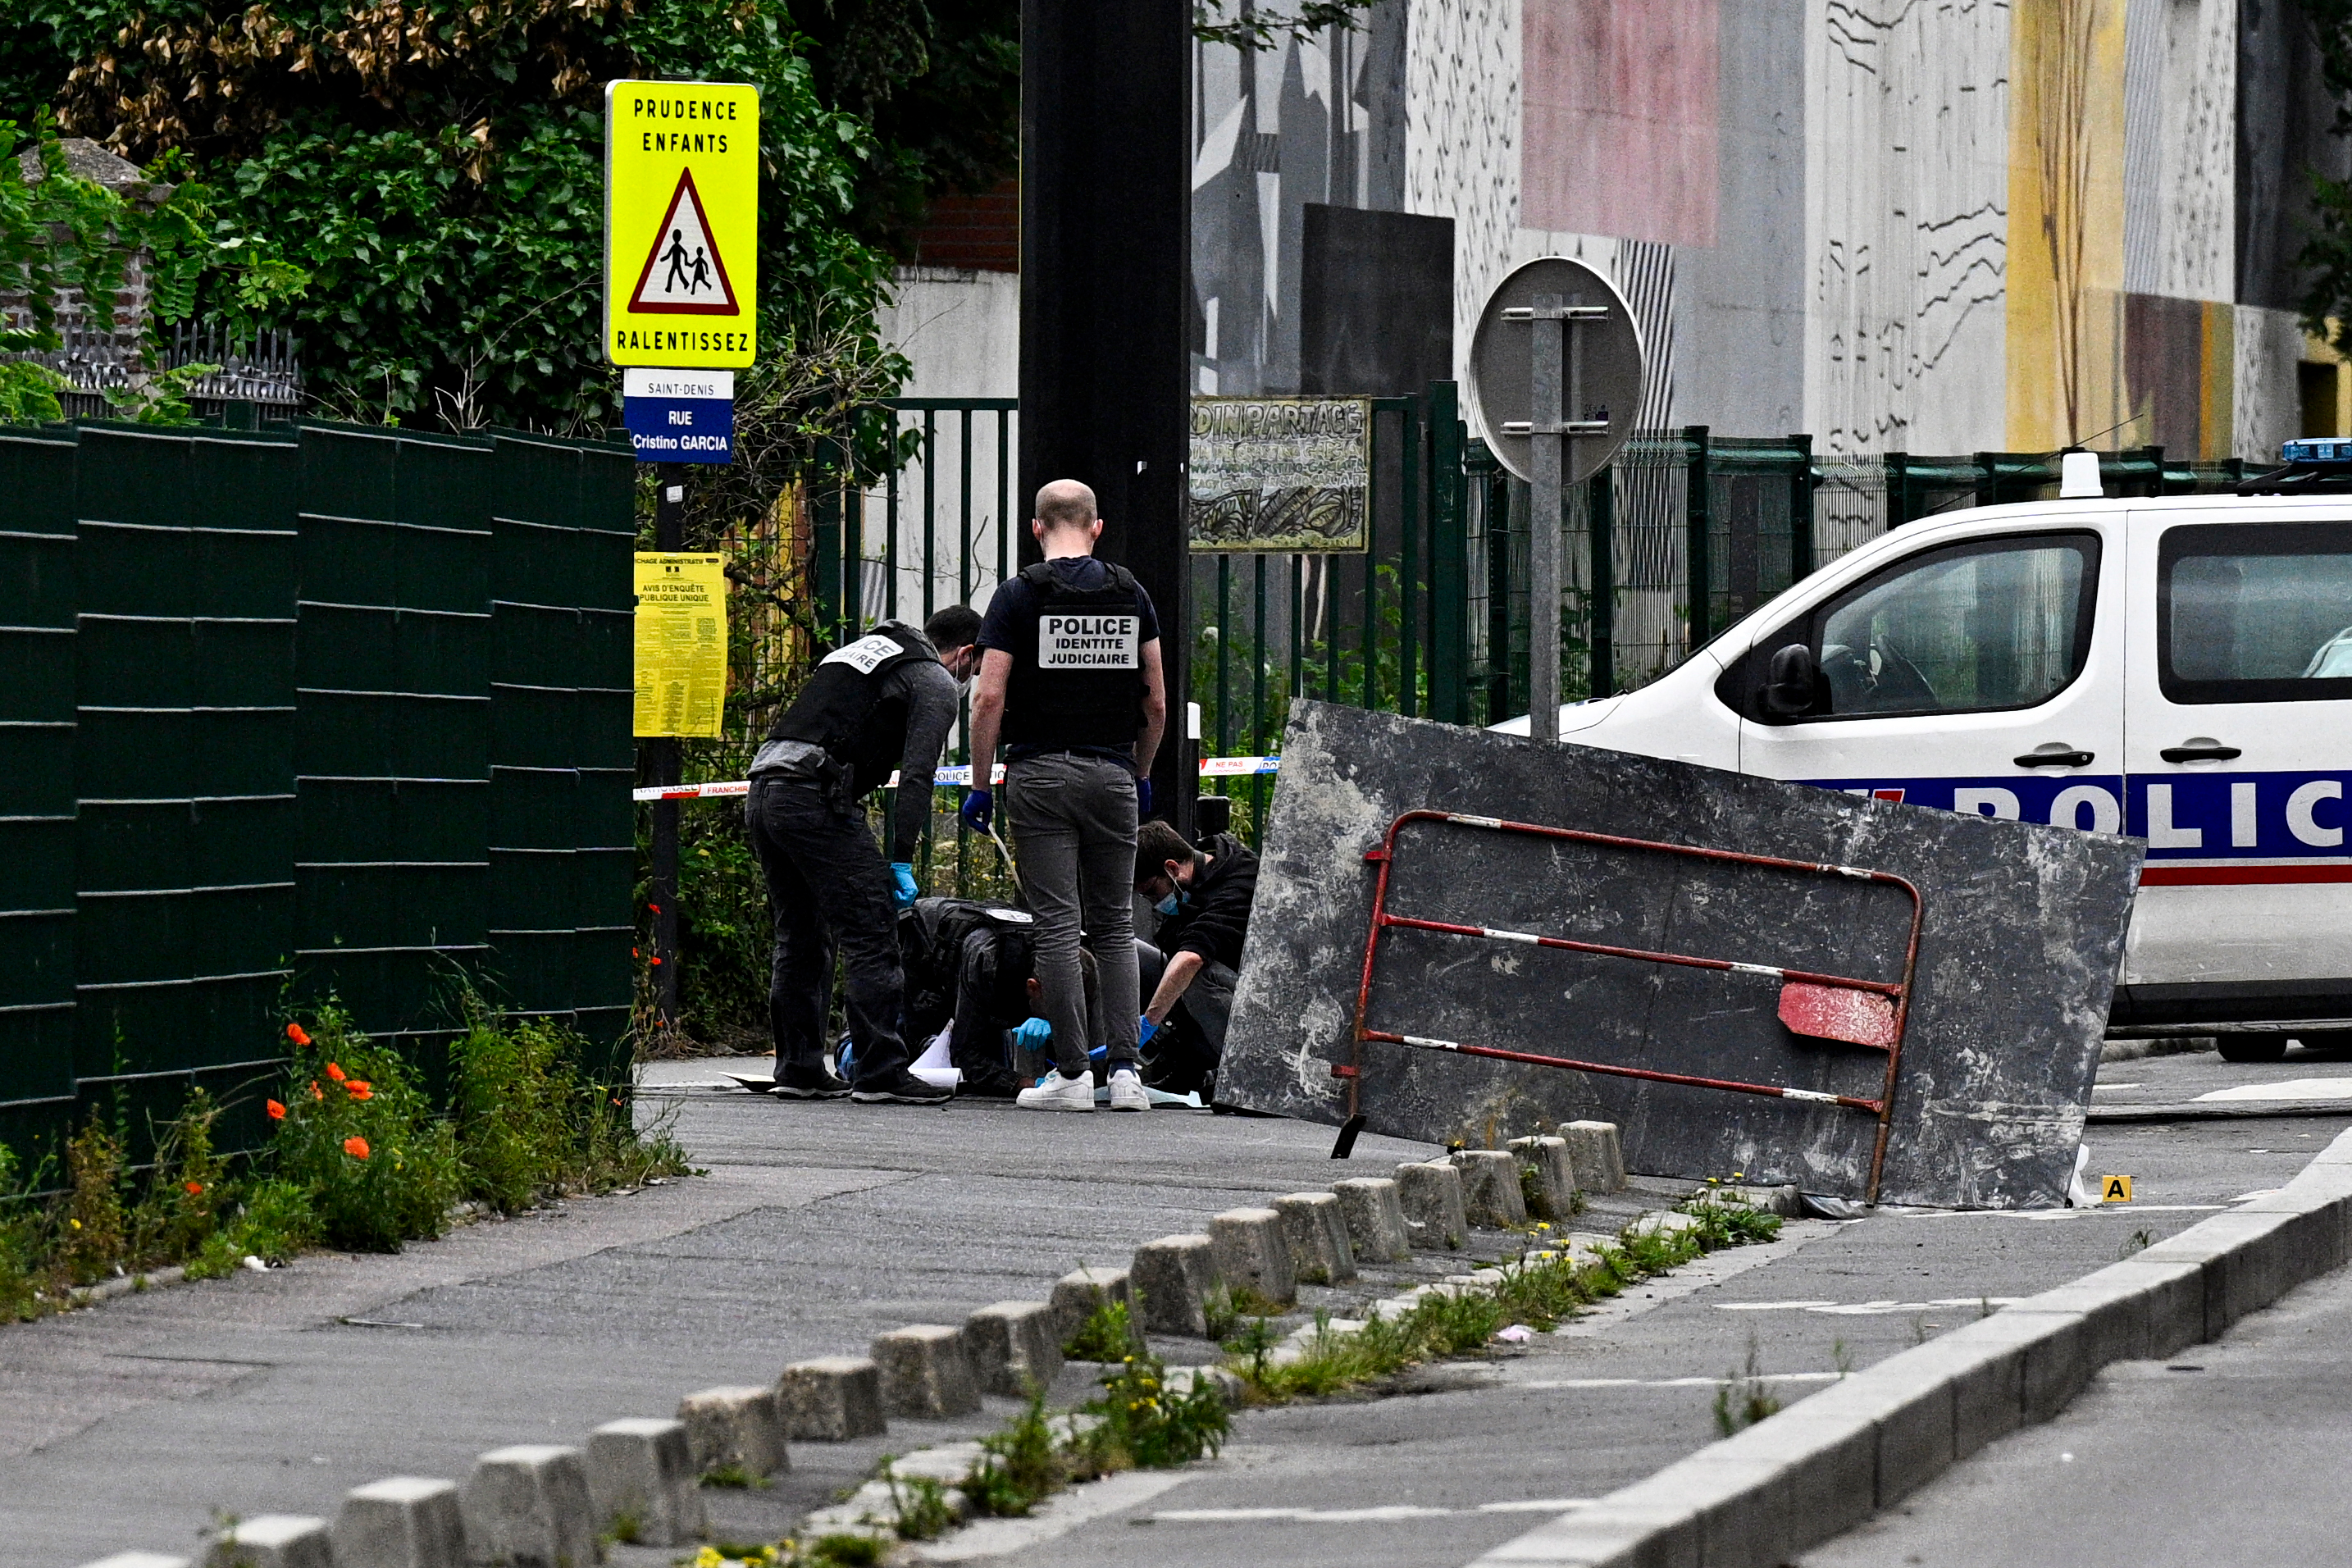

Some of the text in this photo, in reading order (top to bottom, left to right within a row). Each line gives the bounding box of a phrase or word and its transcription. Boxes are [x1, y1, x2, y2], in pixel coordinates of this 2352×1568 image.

[635, 98, 737, 121] PRUDENCE
[643, 133, 728, 153] ENFANTS
[618, 330, 748, 352] RALENTISSEZ
[648, 383, 714, 395] SAINT-DENIS
[668, 410, 693, 425] RUE
[1190, 403, 1242, 441] DIN
[633, 434, 728, 451] Cristino GARCIA
[642, 583, 705, 593] AVIS D'ENQUÊTE
[640, 594, 679, 602] PUBLIQUE
[1049, 618, 1133, 636] POLICE
[1055, 638, 1124, 650] IDENTITE
[1048, 653, 1130, 664] JUDICIAIRE
[2107, 1179, 2125, 1198] A
